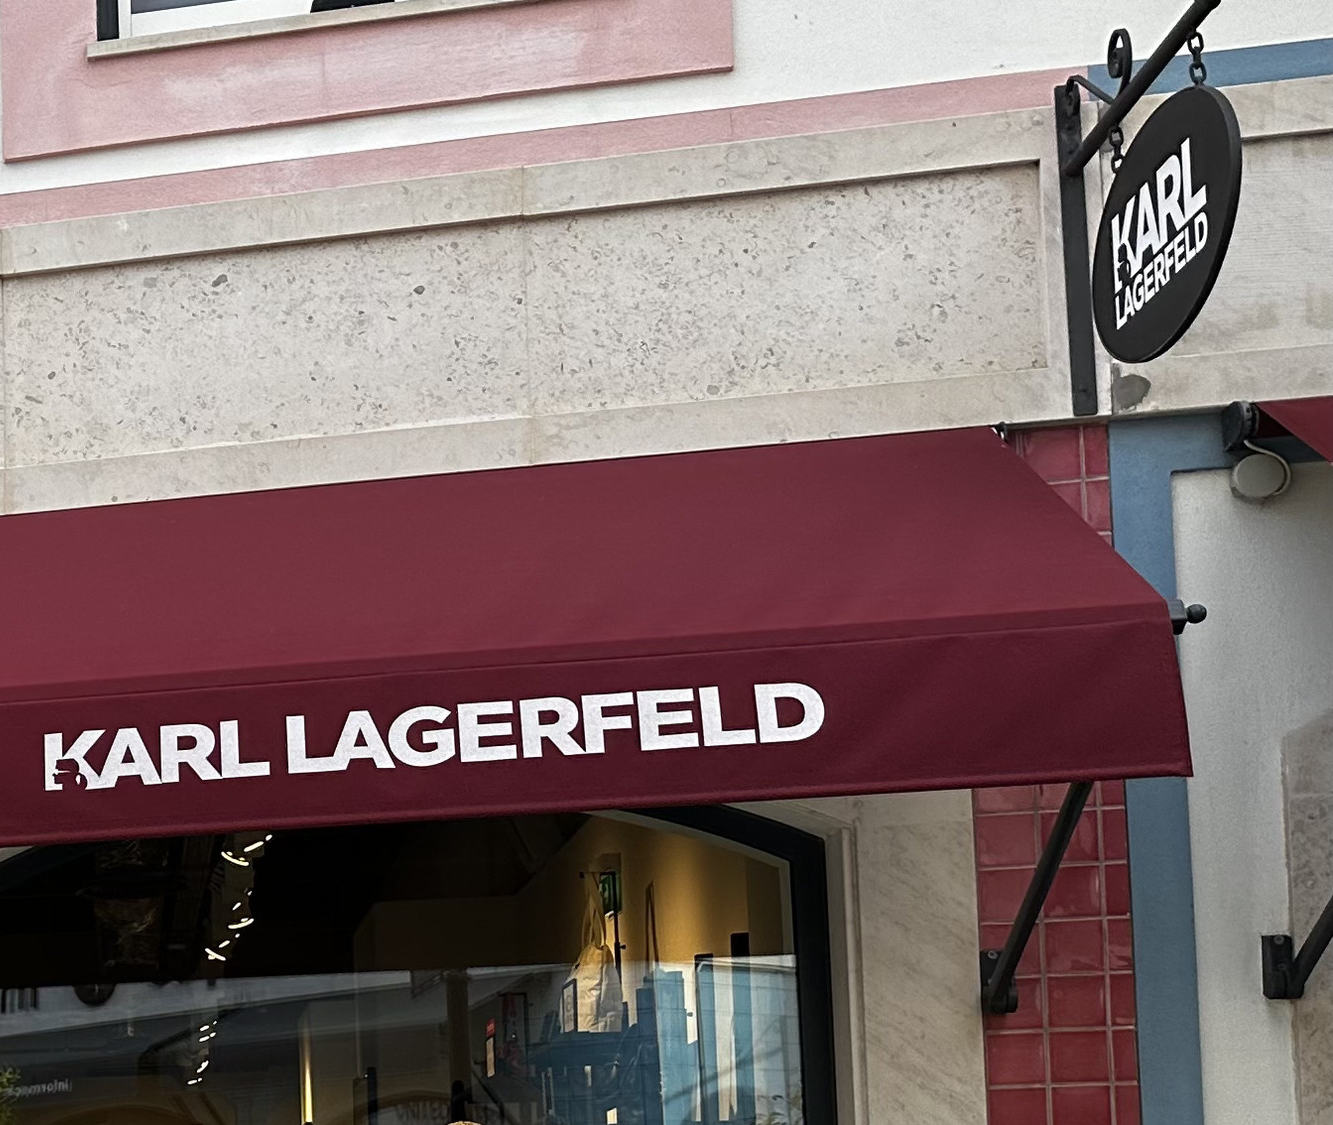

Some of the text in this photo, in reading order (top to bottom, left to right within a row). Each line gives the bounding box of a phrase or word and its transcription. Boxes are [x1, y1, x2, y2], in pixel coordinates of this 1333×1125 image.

[1111, 137, 1207, 294] KARL
[1114, 211, 1208, 330] LAGERFELD
[44, 682, 826, 792] KARL LAGERFELD
